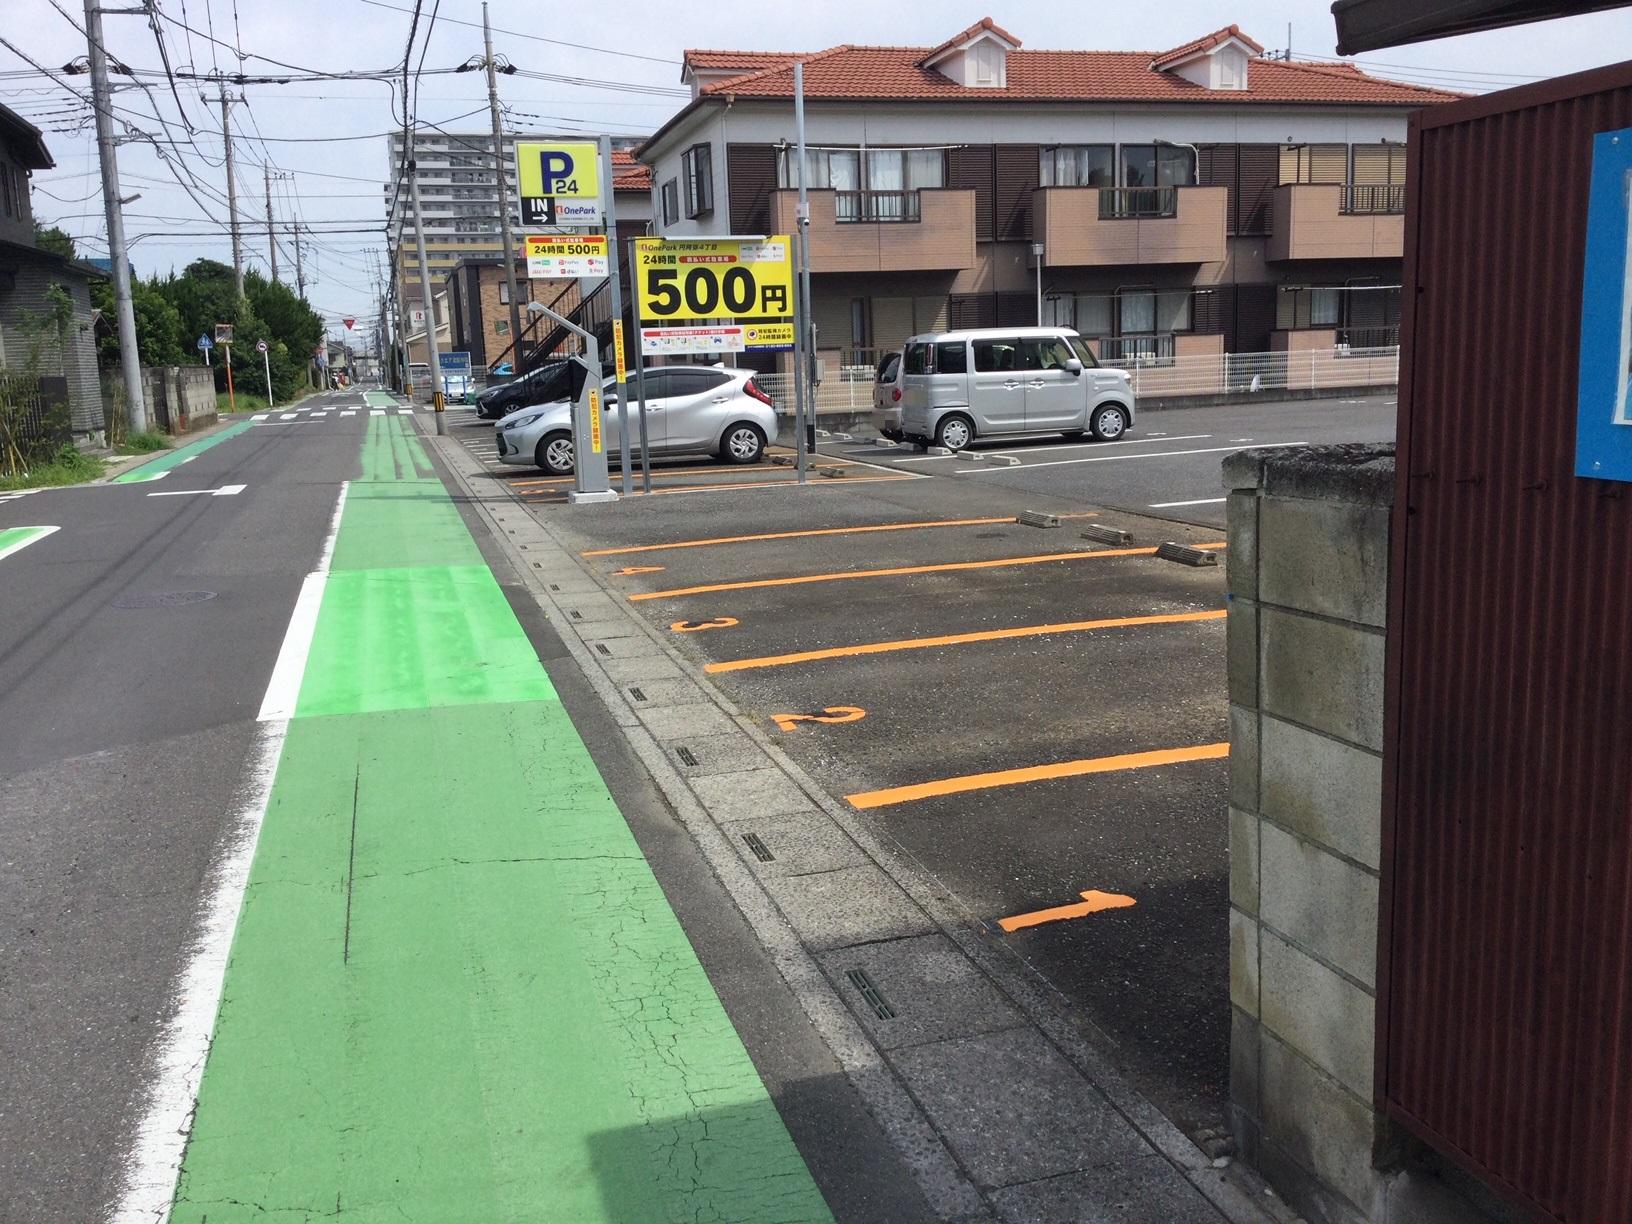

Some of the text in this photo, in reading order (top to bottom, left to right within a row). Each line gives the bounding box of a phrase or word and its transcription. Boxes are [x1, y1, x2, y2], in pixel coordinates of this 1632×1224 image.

[540, 151, 574, 195] P
[556, 180, 579, 194] 24
[531, 198, 548, 212] IN
[564, 206, 596, 215] OnePark
[534, 244, 600, 255] 24時間 500円
[643, 255, 677, 265] 24時間
[647, 266, 788, 315] 500円
[669, 616, 740, 633] 3
[771, 706, 867, 733] 2
[997, 889, 1137, 933] 1
